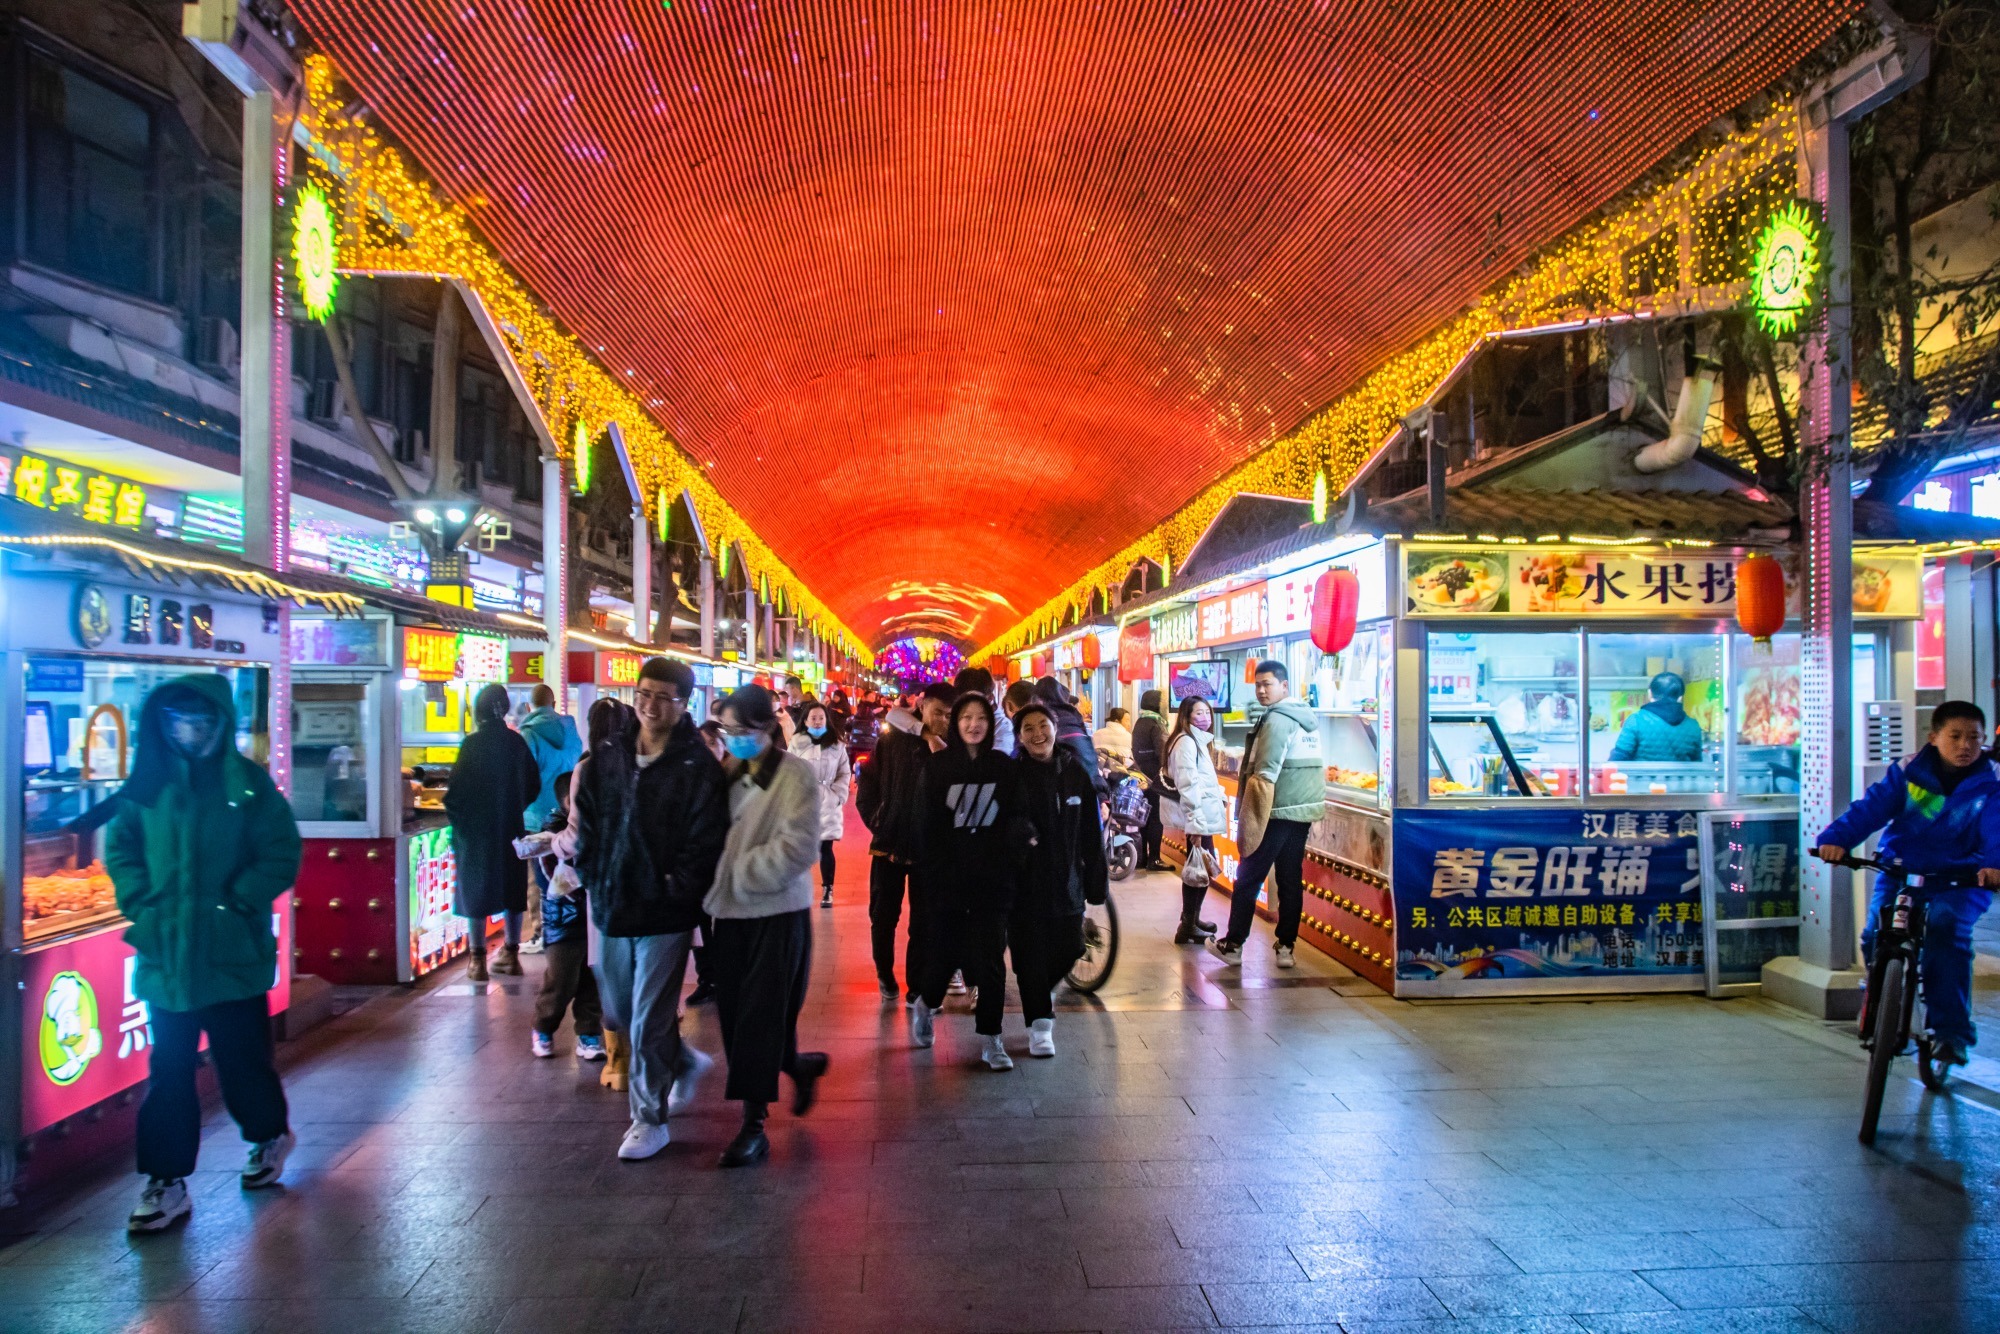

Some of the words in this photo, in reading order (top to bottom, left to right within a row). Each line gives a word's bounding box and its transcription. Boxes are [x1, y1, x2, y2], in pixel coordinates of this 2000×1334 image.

[1576, 562, 1738, 605] 水果捞
[1582, 812, 1733, 839] 汉唐美食
[1430, 846, 1653, 898] 黄金旺铺
[1681, 843, 1800, 894] 火爆
